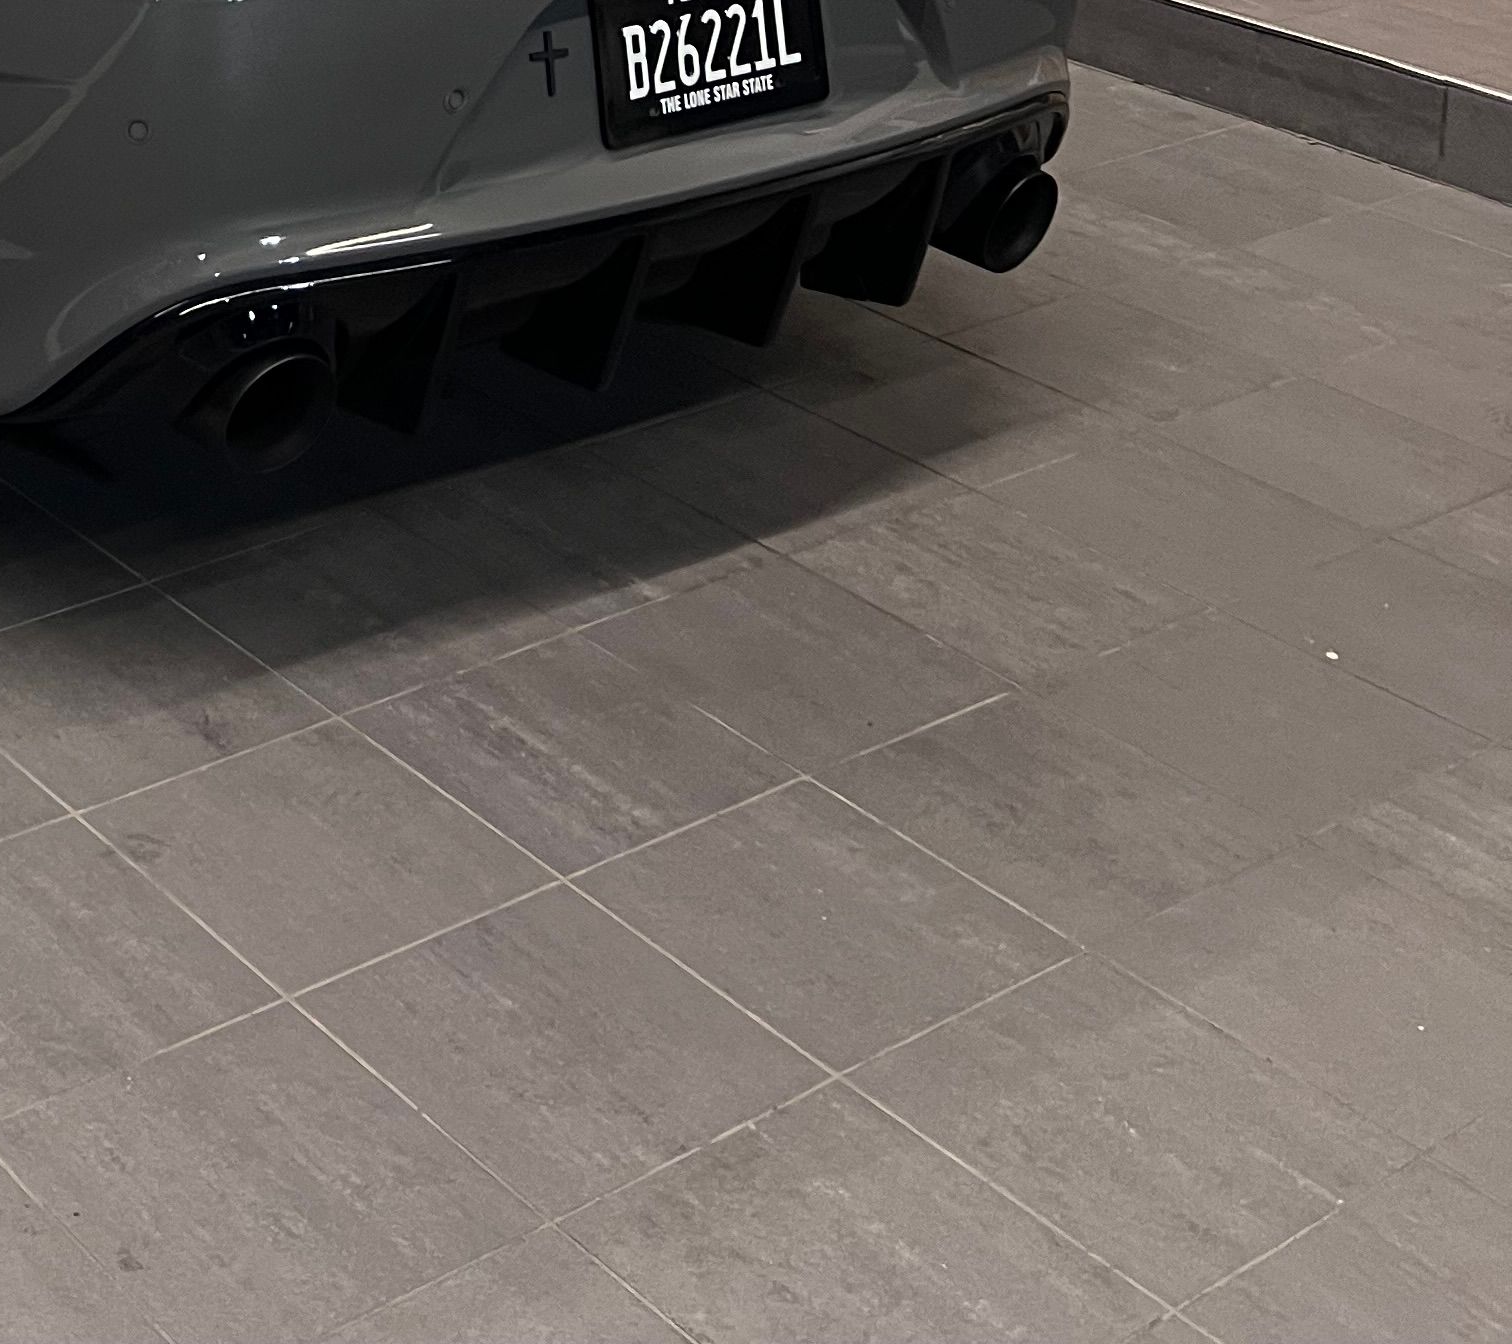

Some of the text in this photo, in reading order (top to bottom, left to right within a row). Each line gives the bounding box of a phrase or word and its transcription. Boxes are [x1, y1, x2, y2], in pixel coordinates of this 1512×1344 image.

[659, 73, 775, 115] THE LONE STAR STATE
